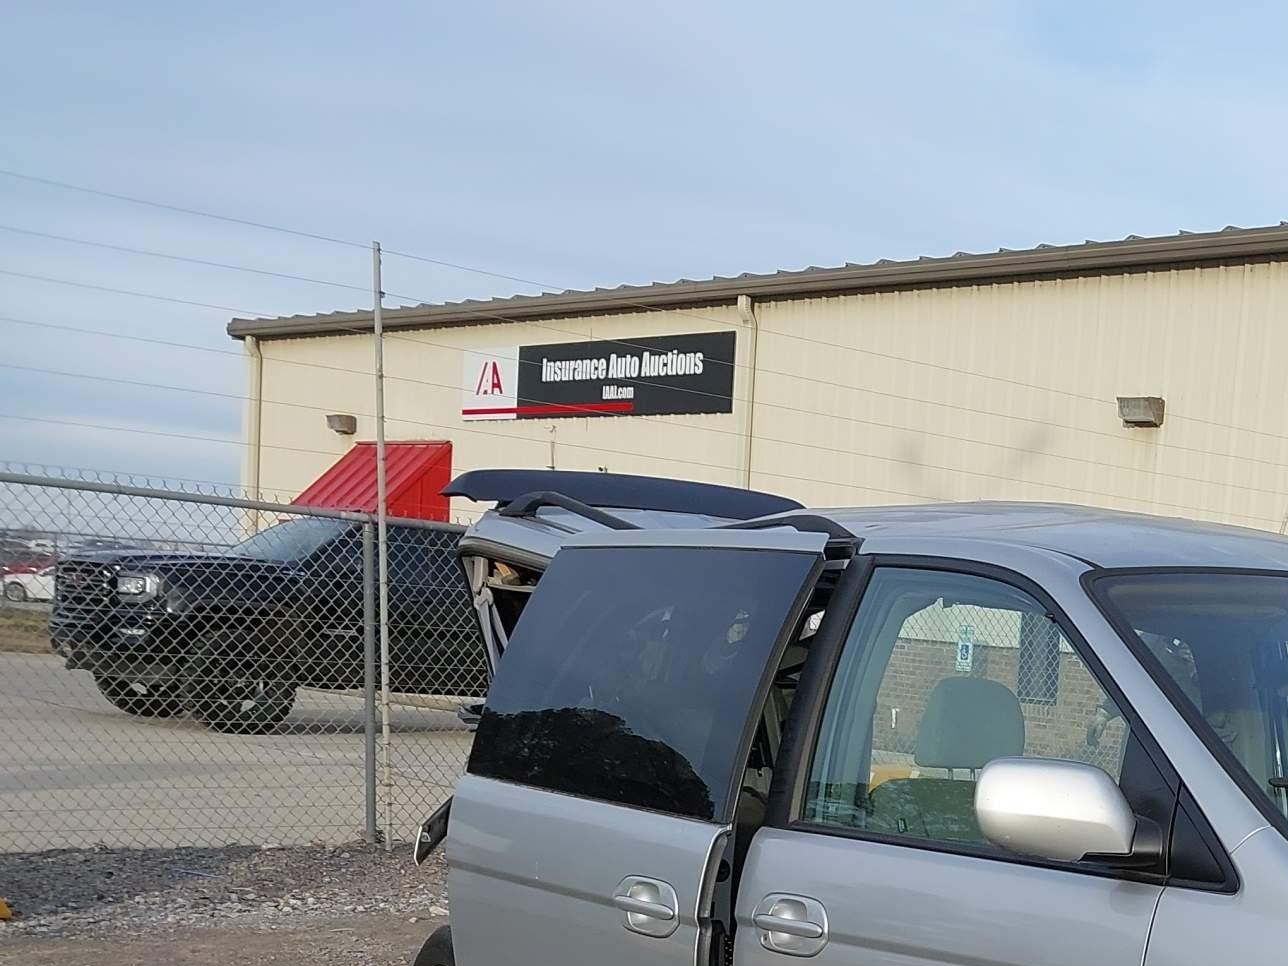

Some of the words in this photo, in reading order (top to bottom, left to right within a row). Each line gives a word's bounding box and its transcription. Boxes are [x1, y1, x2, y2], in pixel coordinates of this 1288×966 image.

[541, 357, 607, 383] Insurance
[608, 353, 640, 379] Auto
[640, 349, 704, 377] Auctions
